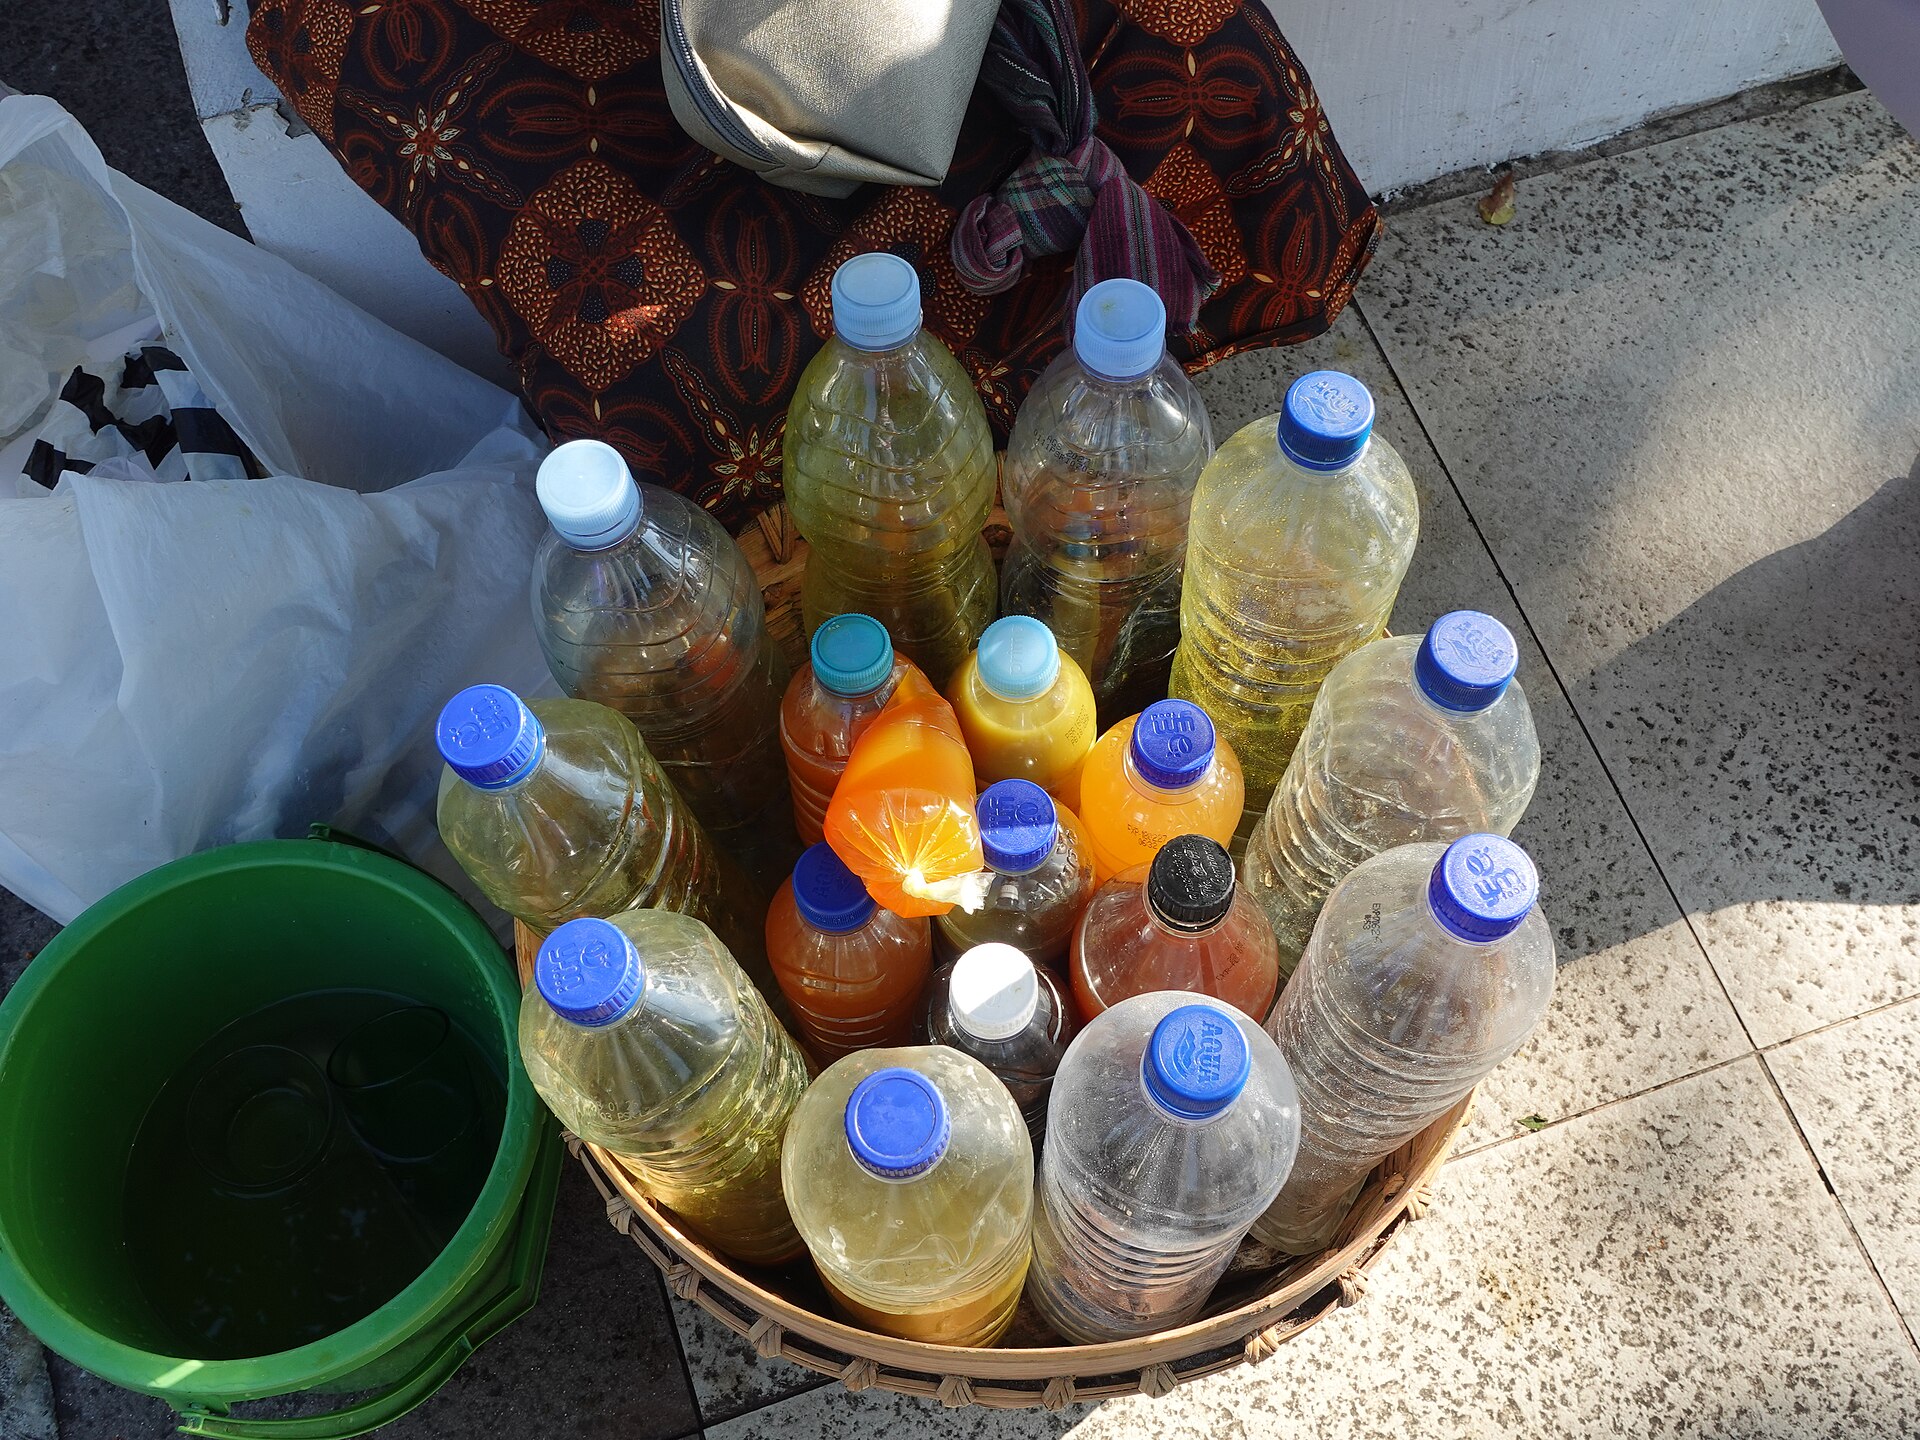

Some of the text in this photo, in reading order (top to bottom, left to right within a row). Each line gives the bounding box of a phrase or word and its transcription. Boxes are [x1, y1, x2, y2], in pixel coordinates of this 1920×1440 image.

[1308, 380, 1359, 420] AQUA
[1452, 620, 1504, 666] AQUA
[1197, 1020, 1223, 1084] AQUA
